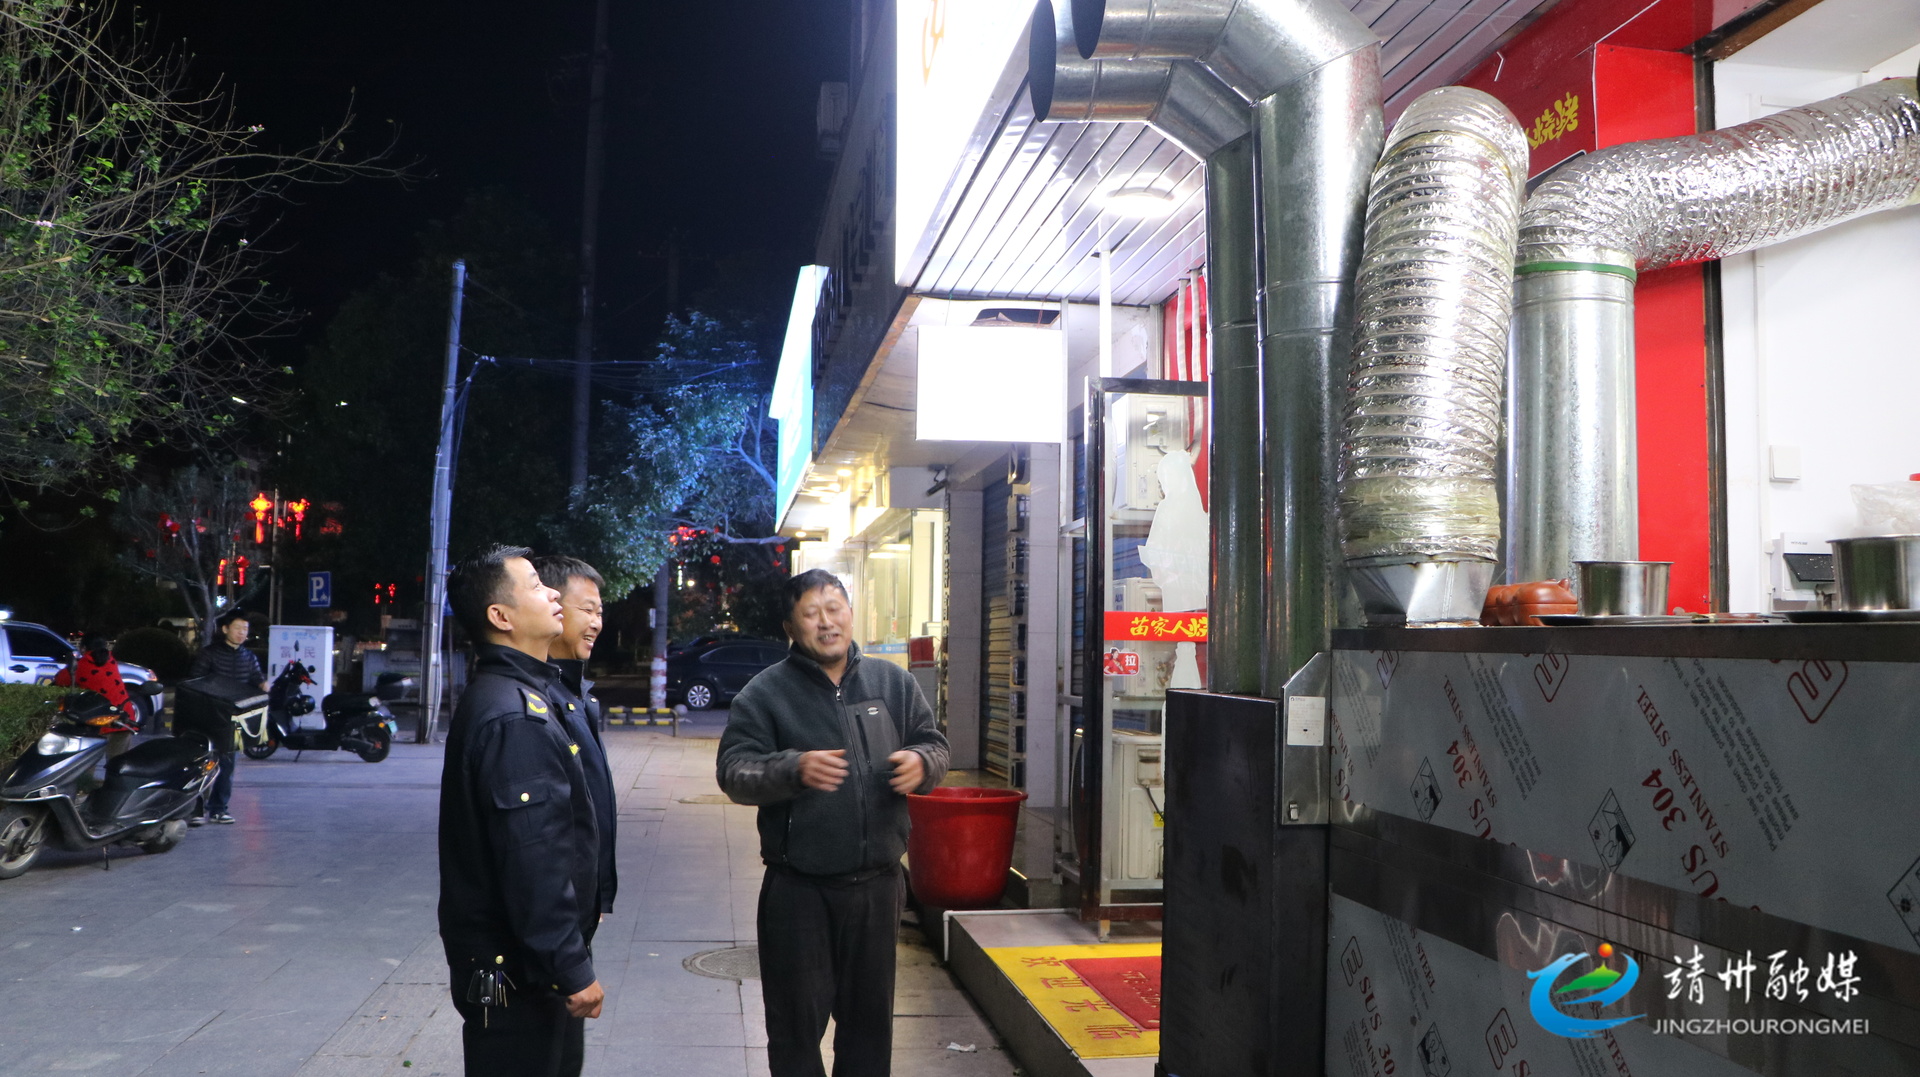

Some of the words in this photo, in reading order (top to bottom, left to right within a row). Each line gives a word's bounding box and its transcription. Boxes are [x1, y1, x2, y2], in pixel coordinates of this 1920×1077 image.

[311, 576, 324, 602] P
[1125, 654, 1137, 666] 拉
[1443, 675, 1464, 724] STEEL
[1638, 685, 1671, 748] STEEL
[1335, 768, 1354, 807] US
[1446, 740, 1472, 789] 304
[1462, 723, 1498, 808] STAINLESS
[1469, 798, 1498, 843] US
[1641, 768, 1687, 832] 304
[1669, 749, 1729, 859] STAINLESS
[1681, 844, 1728, 903] US
[1415, 942, 1436, 994] STEEL
[1021, 956, 1142, 1040] 欢迎光临
[1359, 976, 1382, 1031] SUS
[1378, 1044, 1395, 1077] 30
